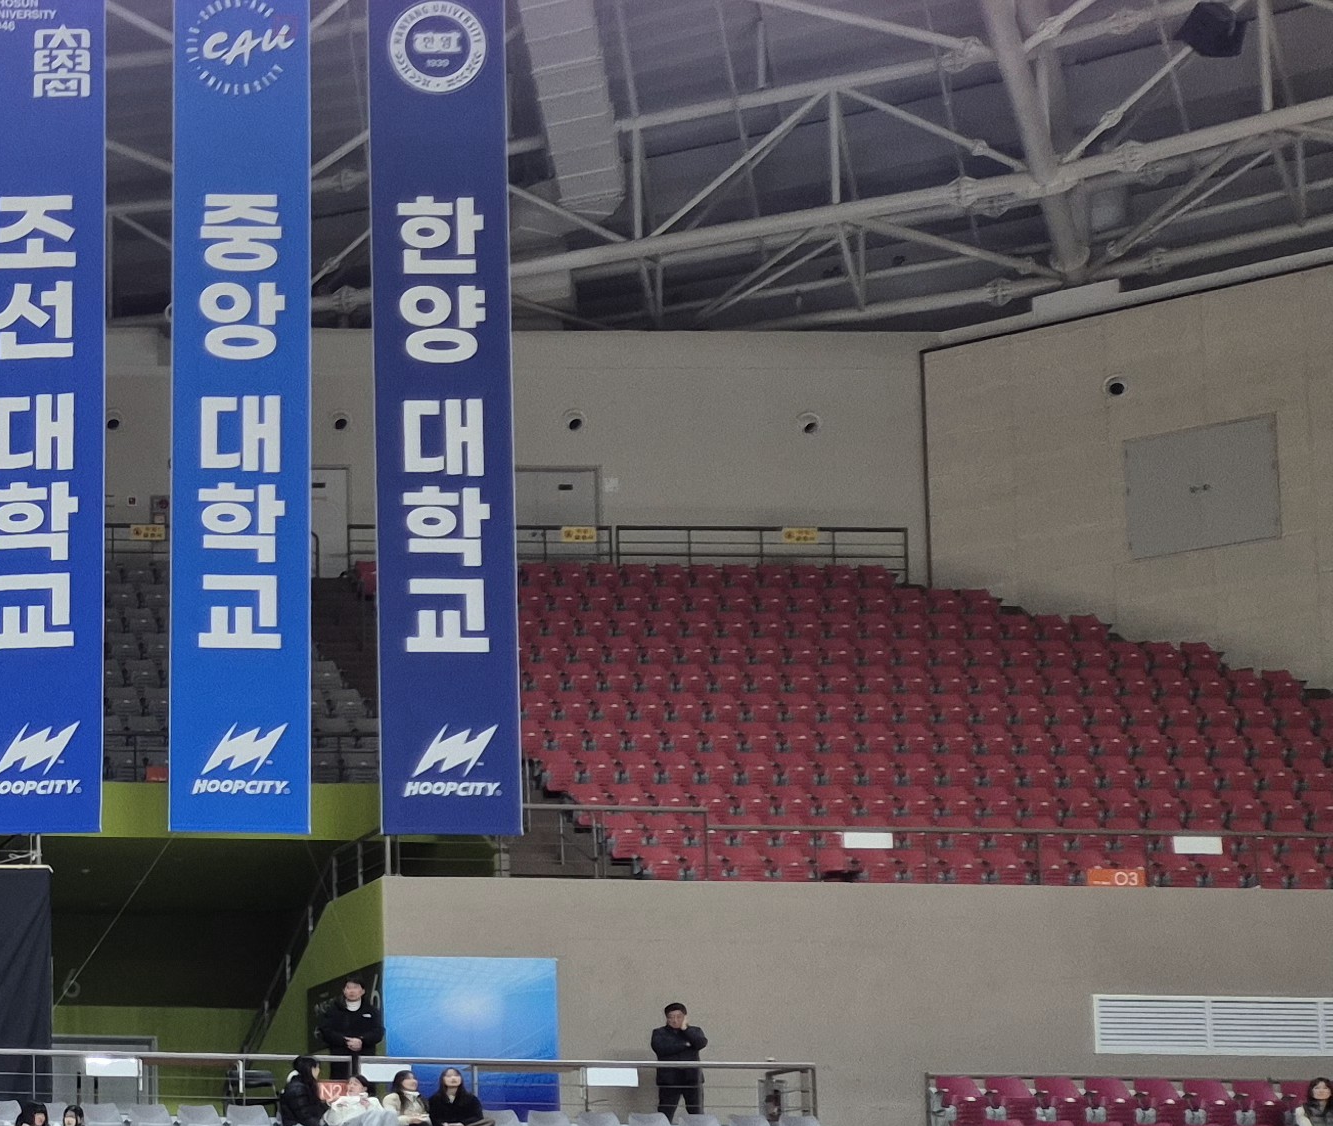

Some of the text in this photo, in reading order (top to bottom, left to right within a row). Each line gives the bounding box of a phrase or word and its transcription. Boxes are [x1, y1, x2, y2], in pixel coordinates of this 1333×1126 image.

[203, 25, 295, 66] CAU
[197, 193, 286, 651] 중앙 대학교
[396, 195, 491, 654] 한양 대학교
[191, 778, 287, 796] HOOPCITY
[403, 780, 499, 797] HOOPCITY
[321, 1085, 342, 1100] N2
